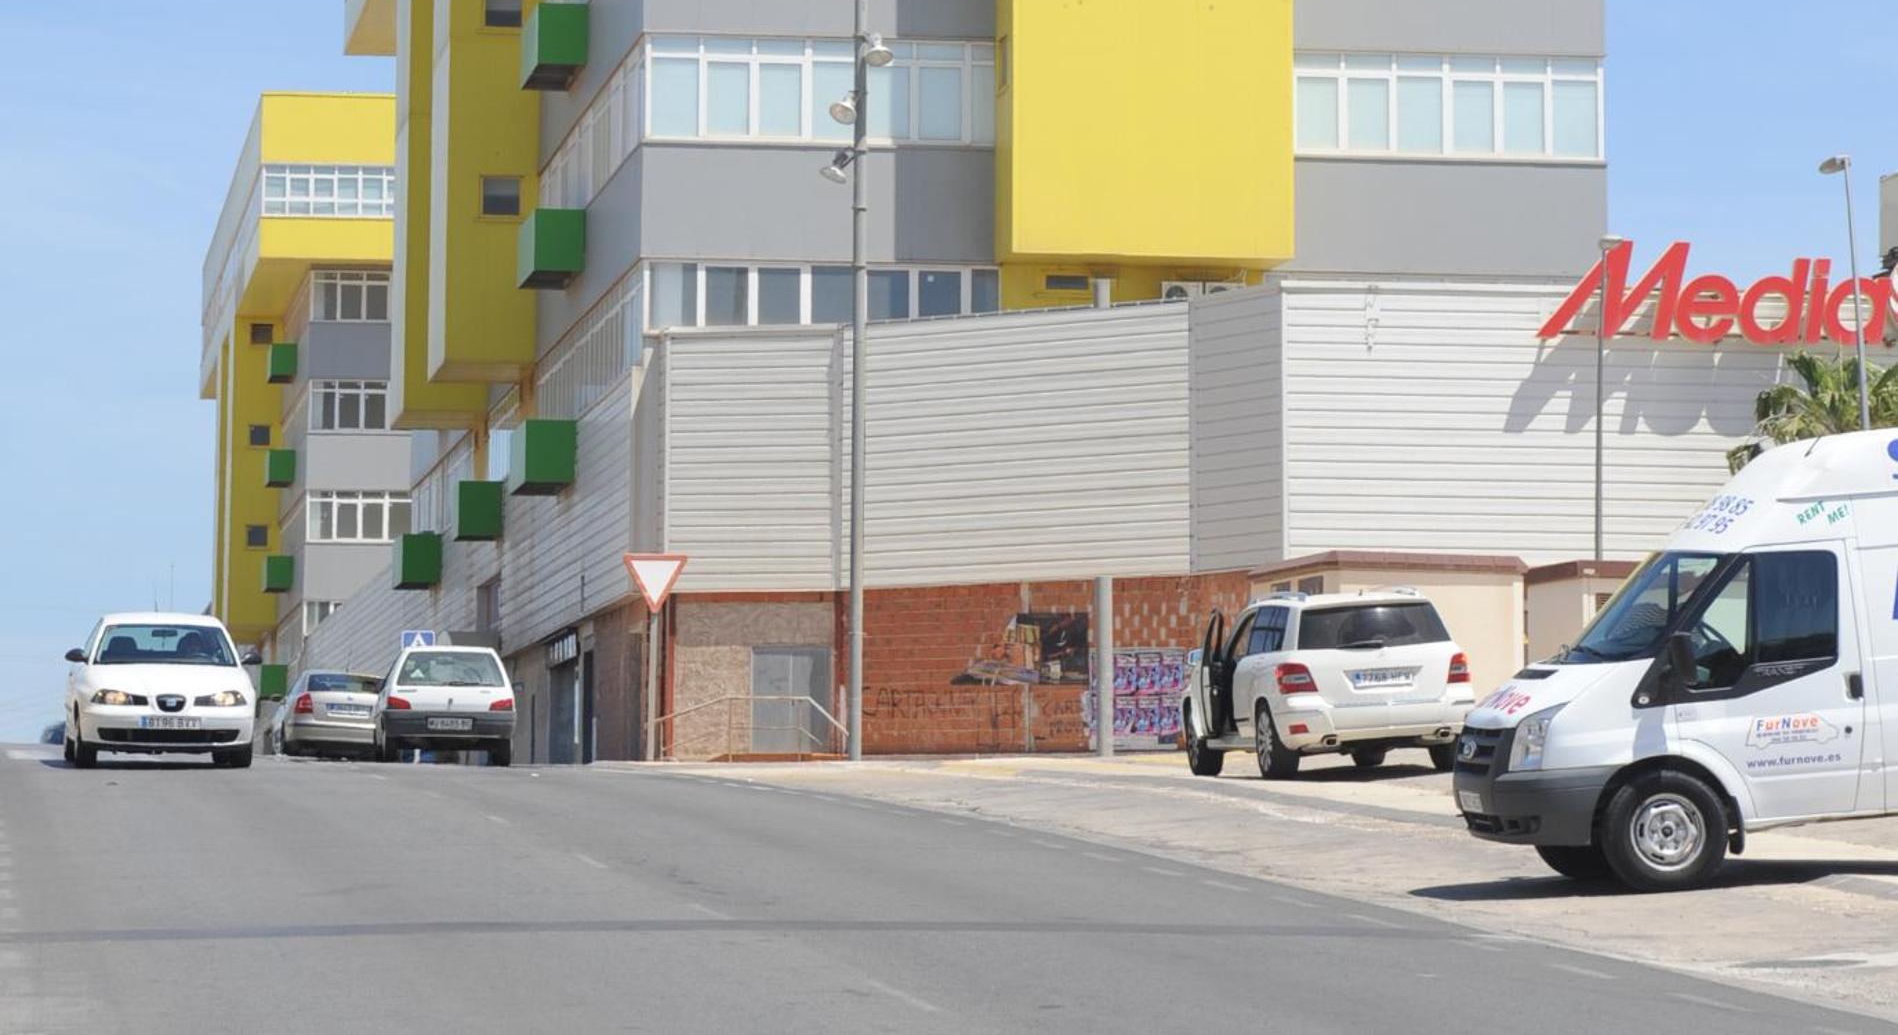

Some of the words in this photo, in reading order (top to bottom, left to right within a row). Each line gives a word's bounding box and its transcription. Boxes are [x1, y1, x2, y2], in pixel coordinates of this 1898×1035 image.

[1535, 240, 1892, 346] Media
[1797, 500, 1826, 526] RENT
[1827, 504, 1849, 525] ME!
[1756, 716, 1818, 731] FurNove
[1746, 753, 1841, 768] www.furnove.es
